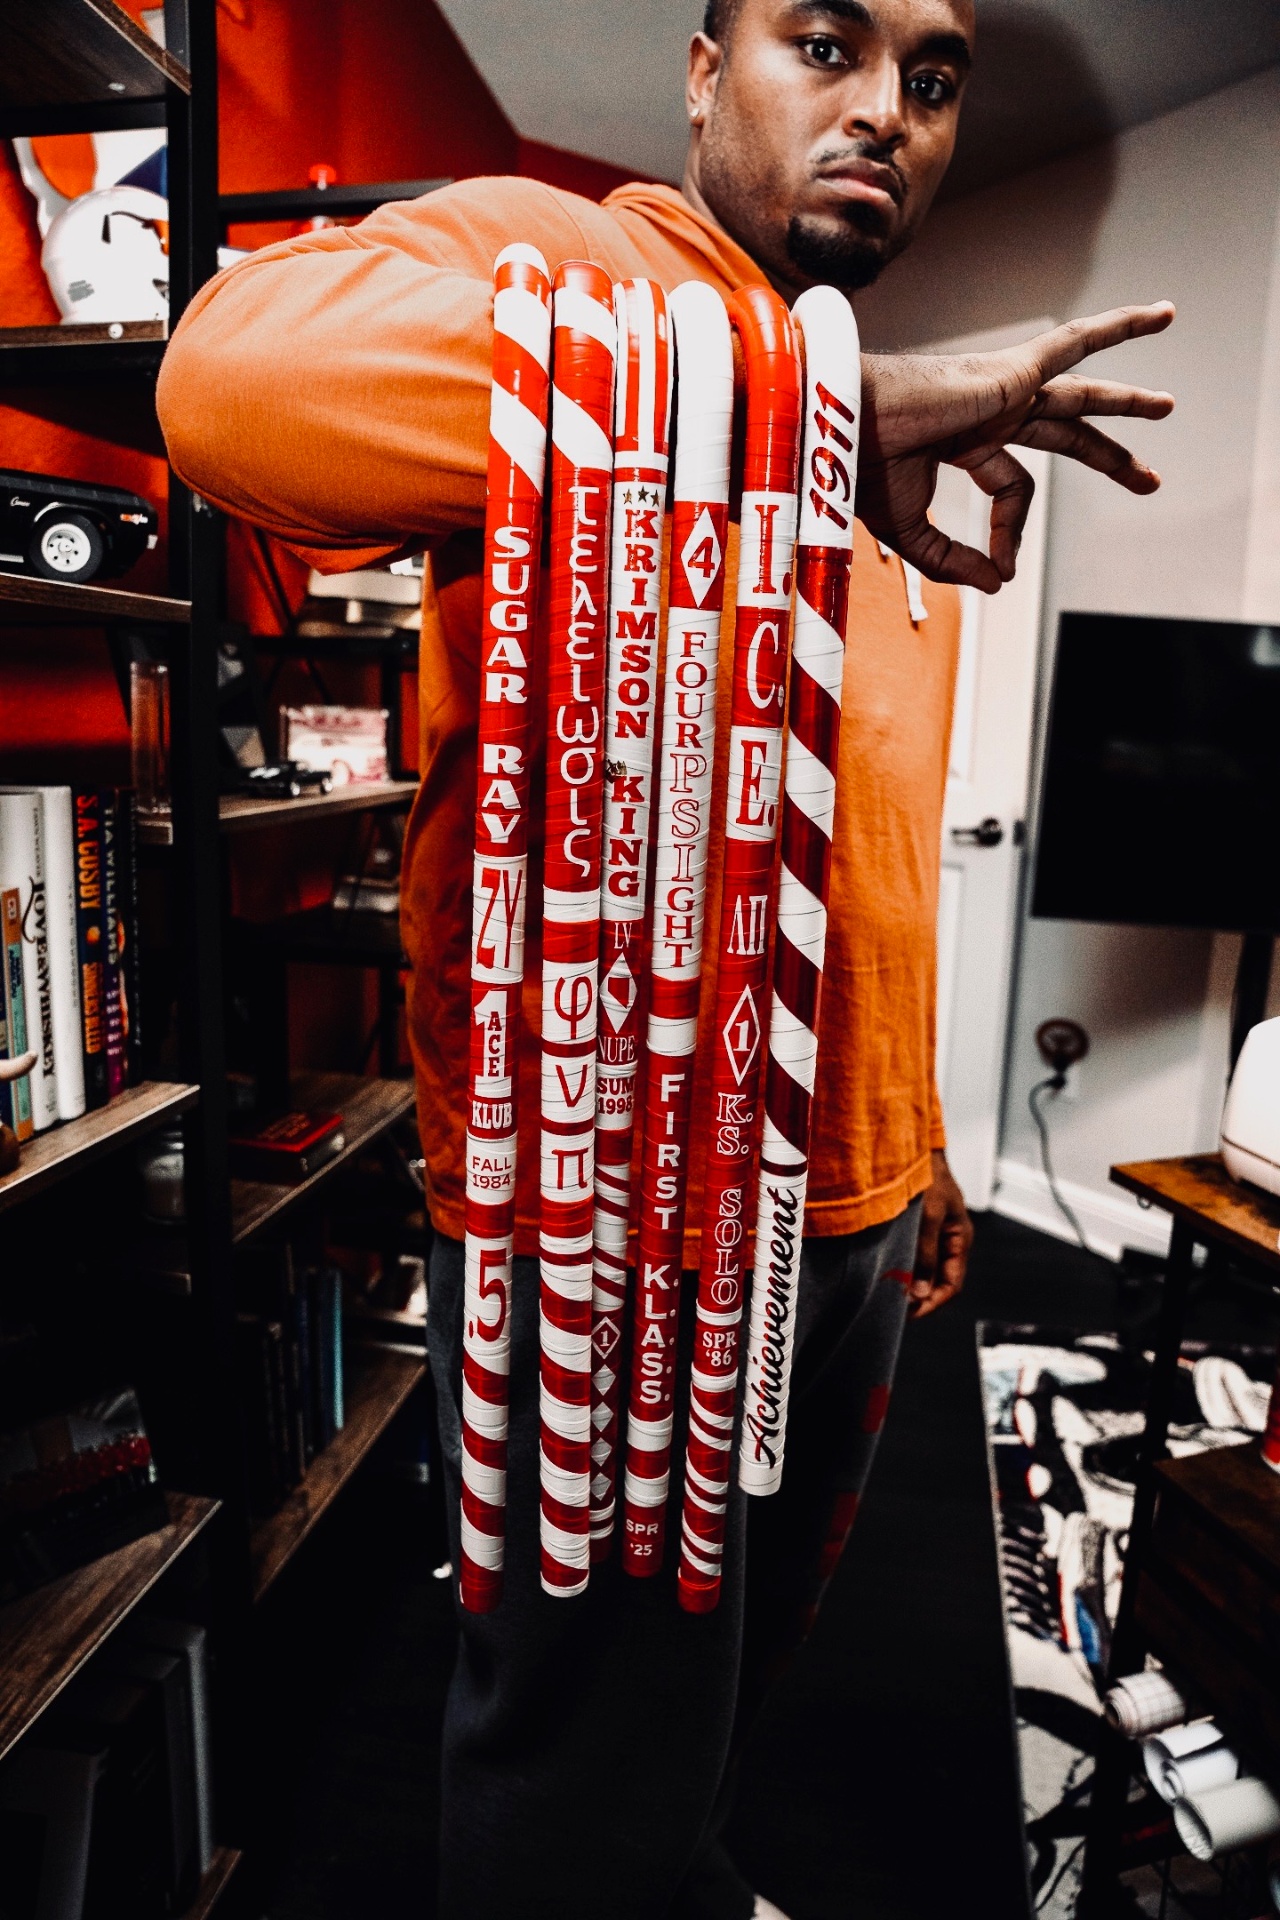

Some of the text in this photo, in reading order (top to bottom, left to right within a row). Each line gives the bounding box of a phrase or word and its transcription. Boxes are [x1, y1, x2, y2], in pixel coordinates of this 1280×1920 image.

[809, 381, 856, 530] 1911
[687, 536, 715, 579] 4
[481, 526, 531, 844] SUGAR RAY
[607, 509, 659, 898] KRIMSON KING
[663, 632, 708, 968] FOURPSIGHT
[78, 841, 101, 910] COSBY
[106, 850, 119, 965] WILLIAMS
[614, 922, 632, 949] LV
[487, 1011, 502, 1077] ACE
[597, 1035, 635, 1063] NUPE
[734, 1022, 750, 1051] 1
[472, 1101, 512, 1129] KLUB
[597, 1097, 633, 1115] 1998
[472, 1156, 512, 1172] FALL
[654, 1073, 685, 1230] FIRST
[473, 1173, 511, 1189] 1984
[711, 1189, 742, 1305] SOLO
[600, 1330, 609, 1346] 1
[702, 1331, 736, 1349] SPR
[745, 1186, 800, 1469] Achievement
[626, 1520, 658, 1535] SPR
